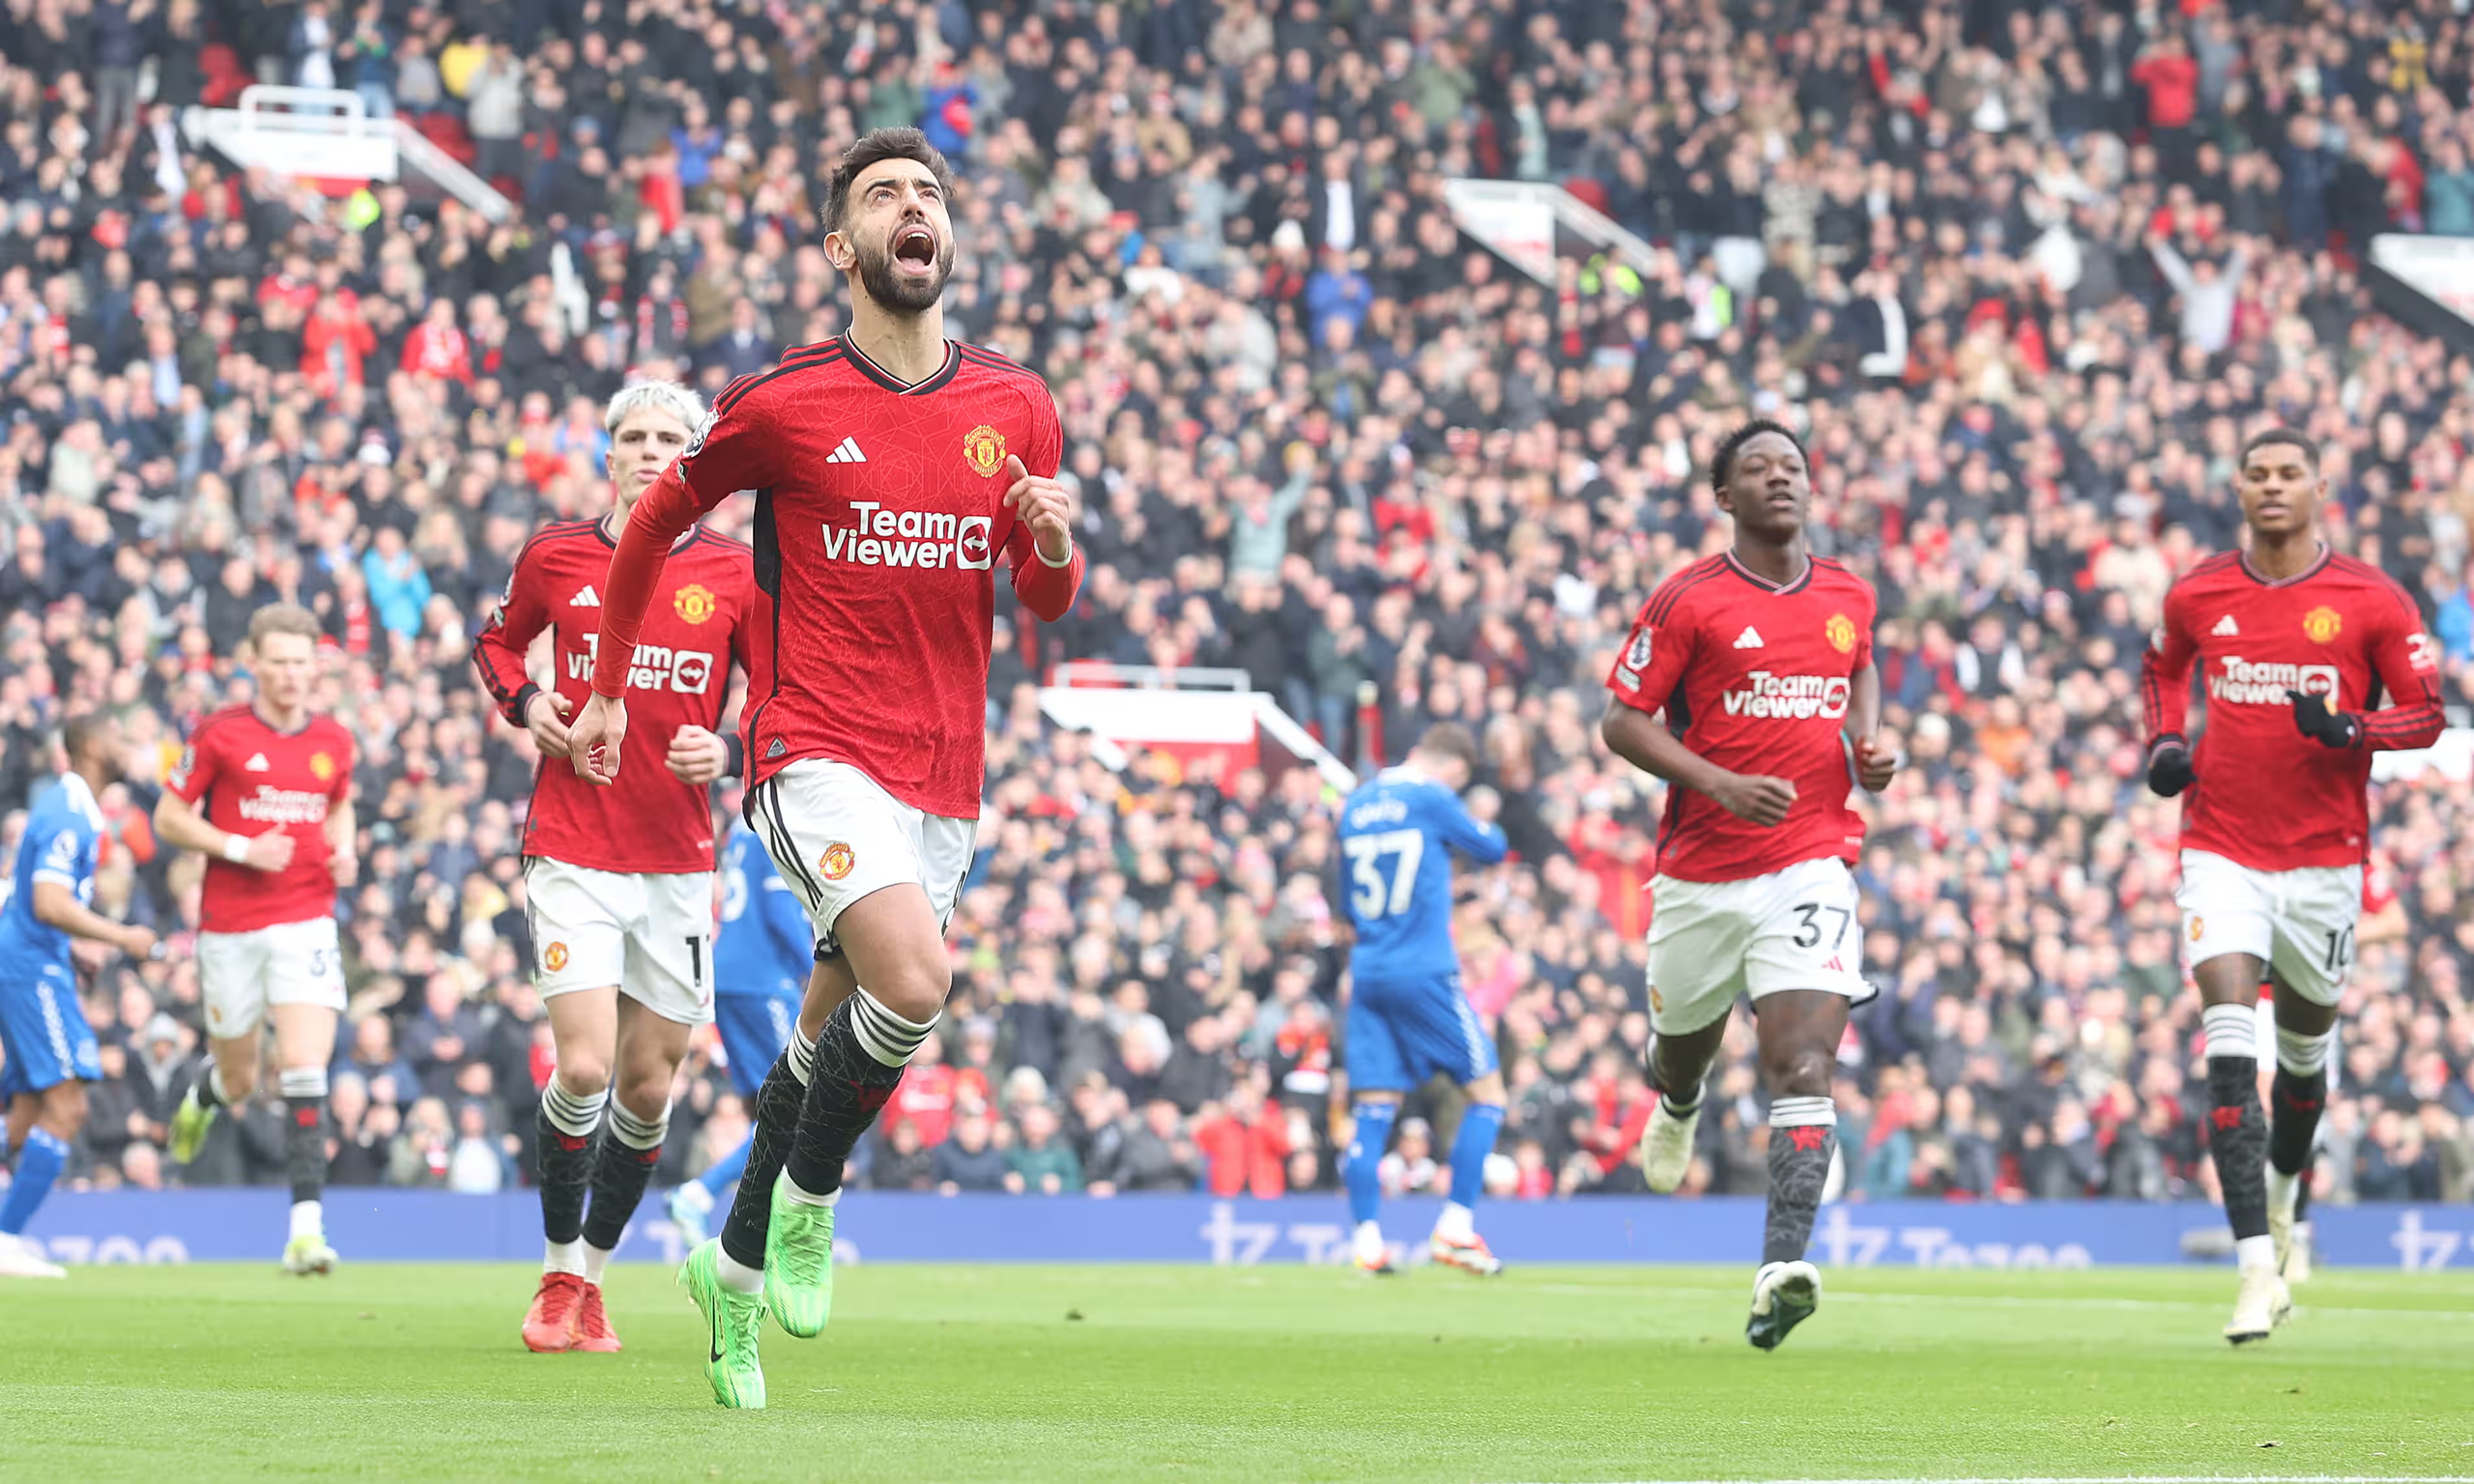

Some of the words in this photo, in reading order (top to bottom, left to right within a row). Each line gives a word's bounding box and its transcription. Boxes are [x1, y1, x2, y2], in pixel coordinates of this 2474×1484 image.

[849, 501, 957, 539] Team
[821, 524, 955, 569] Viewer
[582, 633, 673, 669] Tm
[2221, 655, 2298, 683] Team
[567, 651, 670, 691] Vier
[1747, 671, 1824, 697] Team
[1723, 689, 1822, 719] Viewer
[1344, 828, 1424, 920] 37
[1793, 900, 1851, 950] 37
[685, 933, 710, 987] 1
